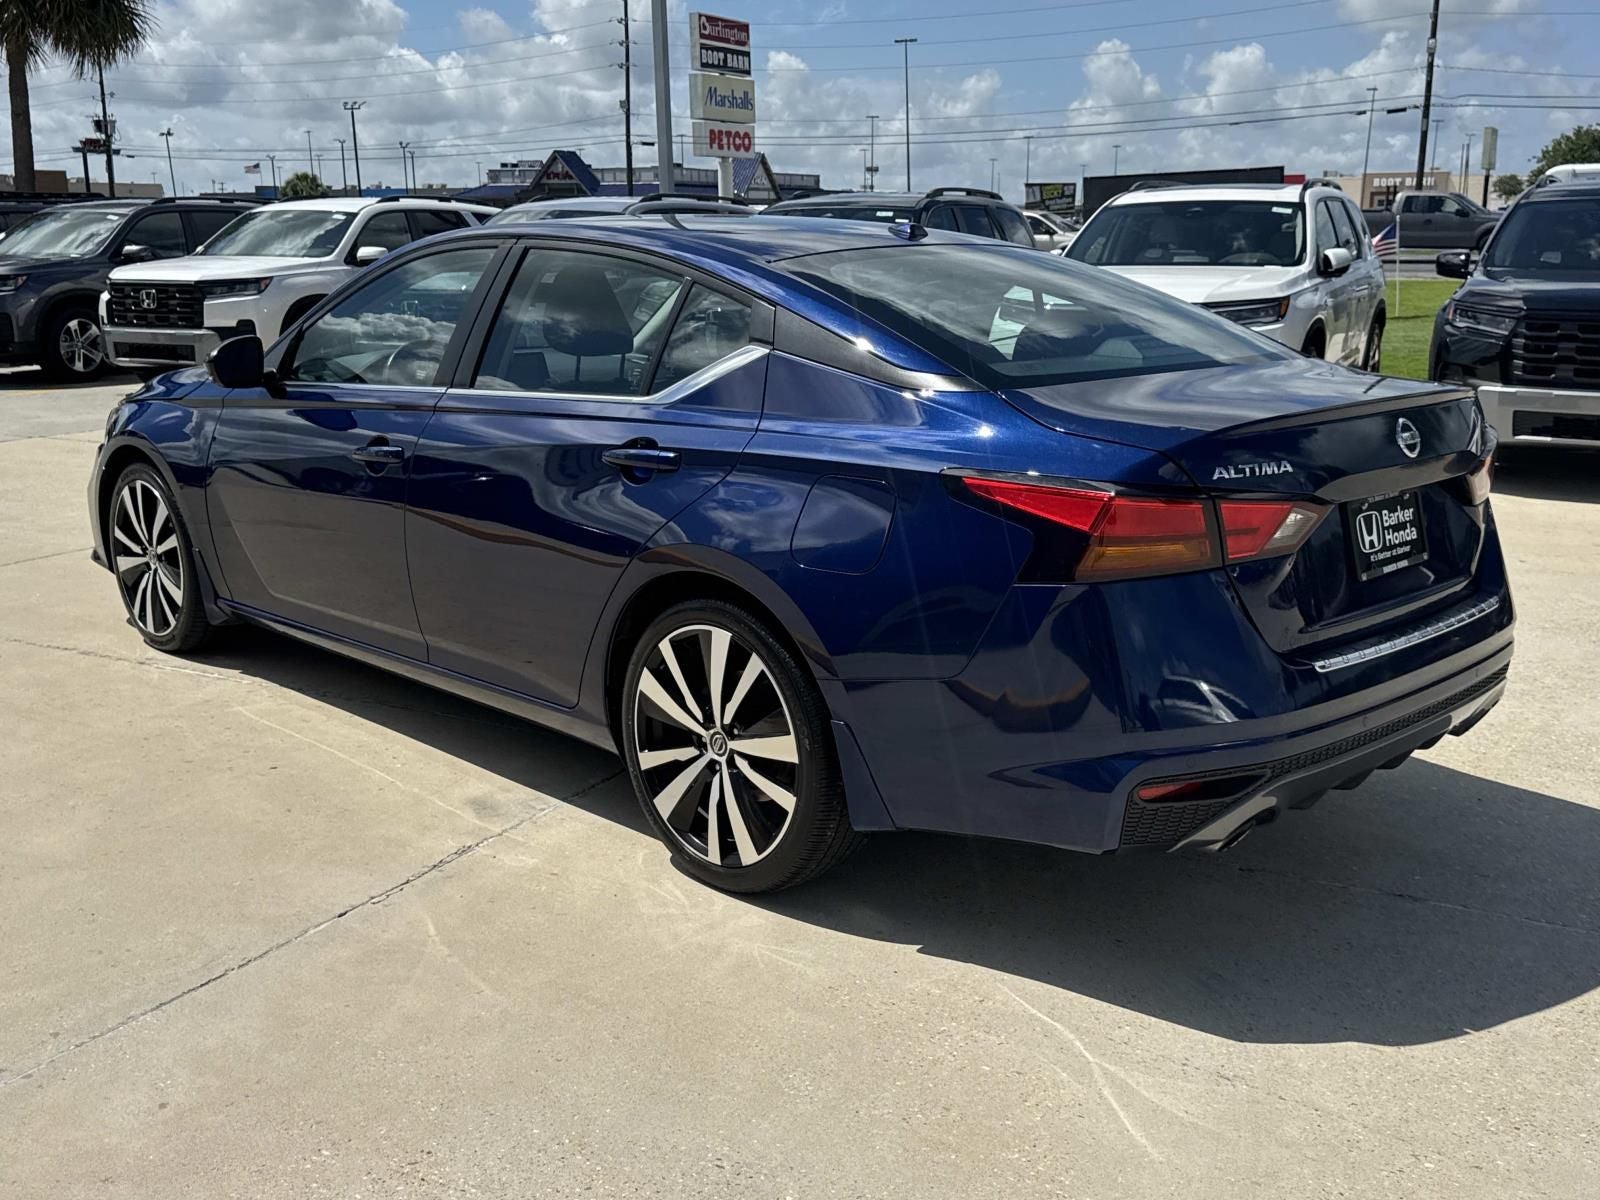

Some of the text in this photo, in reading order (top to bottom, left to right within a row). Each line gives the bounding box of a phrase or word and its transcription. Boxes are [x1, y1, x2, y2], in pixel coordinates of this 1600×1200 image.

[700, 15, 748, 45] Burlington
[701, 49, 749, 71] BOOT BARN
[704, 86, 753, 111] Marshalls
[708, 128, 752, 153] PETCO
[1373, 177, 1401, 187] BOOT
[1212, 460, 1293, 480] ALTIMA
[1381, 505, 1414, 527] Barker
[1384, 522, 1418, 546] Honda
